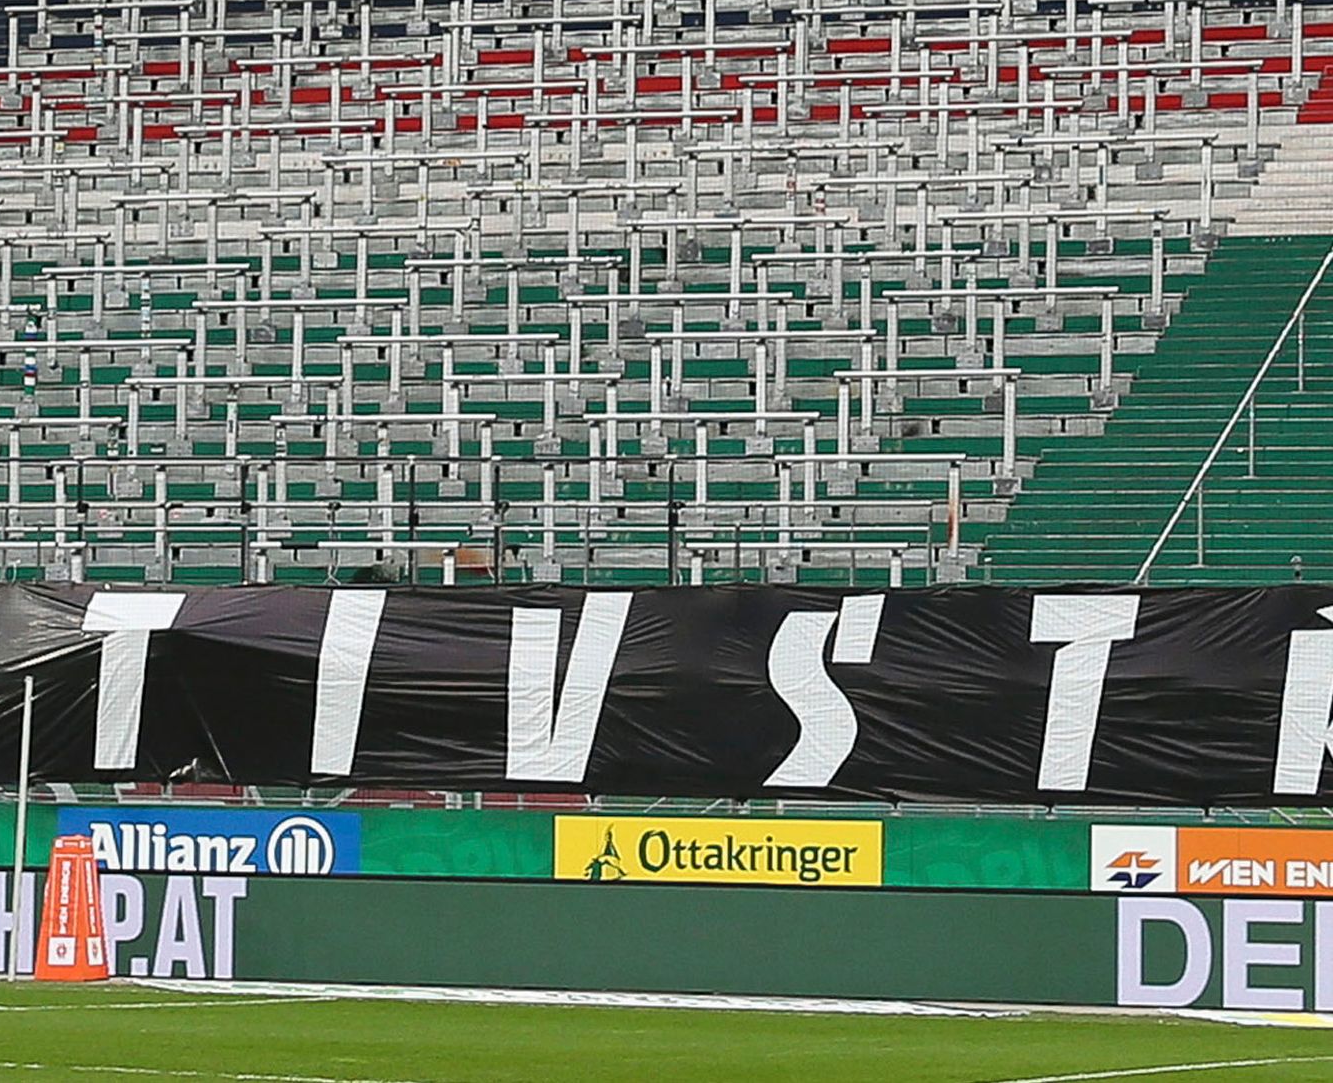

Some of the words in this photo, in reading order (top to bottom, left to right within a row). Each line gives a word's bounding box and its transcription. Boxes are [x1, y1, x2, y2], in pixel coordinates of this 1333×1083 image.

[90, 822, 258, 873] Allianz
[638, 828, 858, 883] Ottakringer
[1188, 858, 1276, 887] WIEN
[1286, 860, 1333, 889] EN
[1117, 897, 1333, 1010] DE
